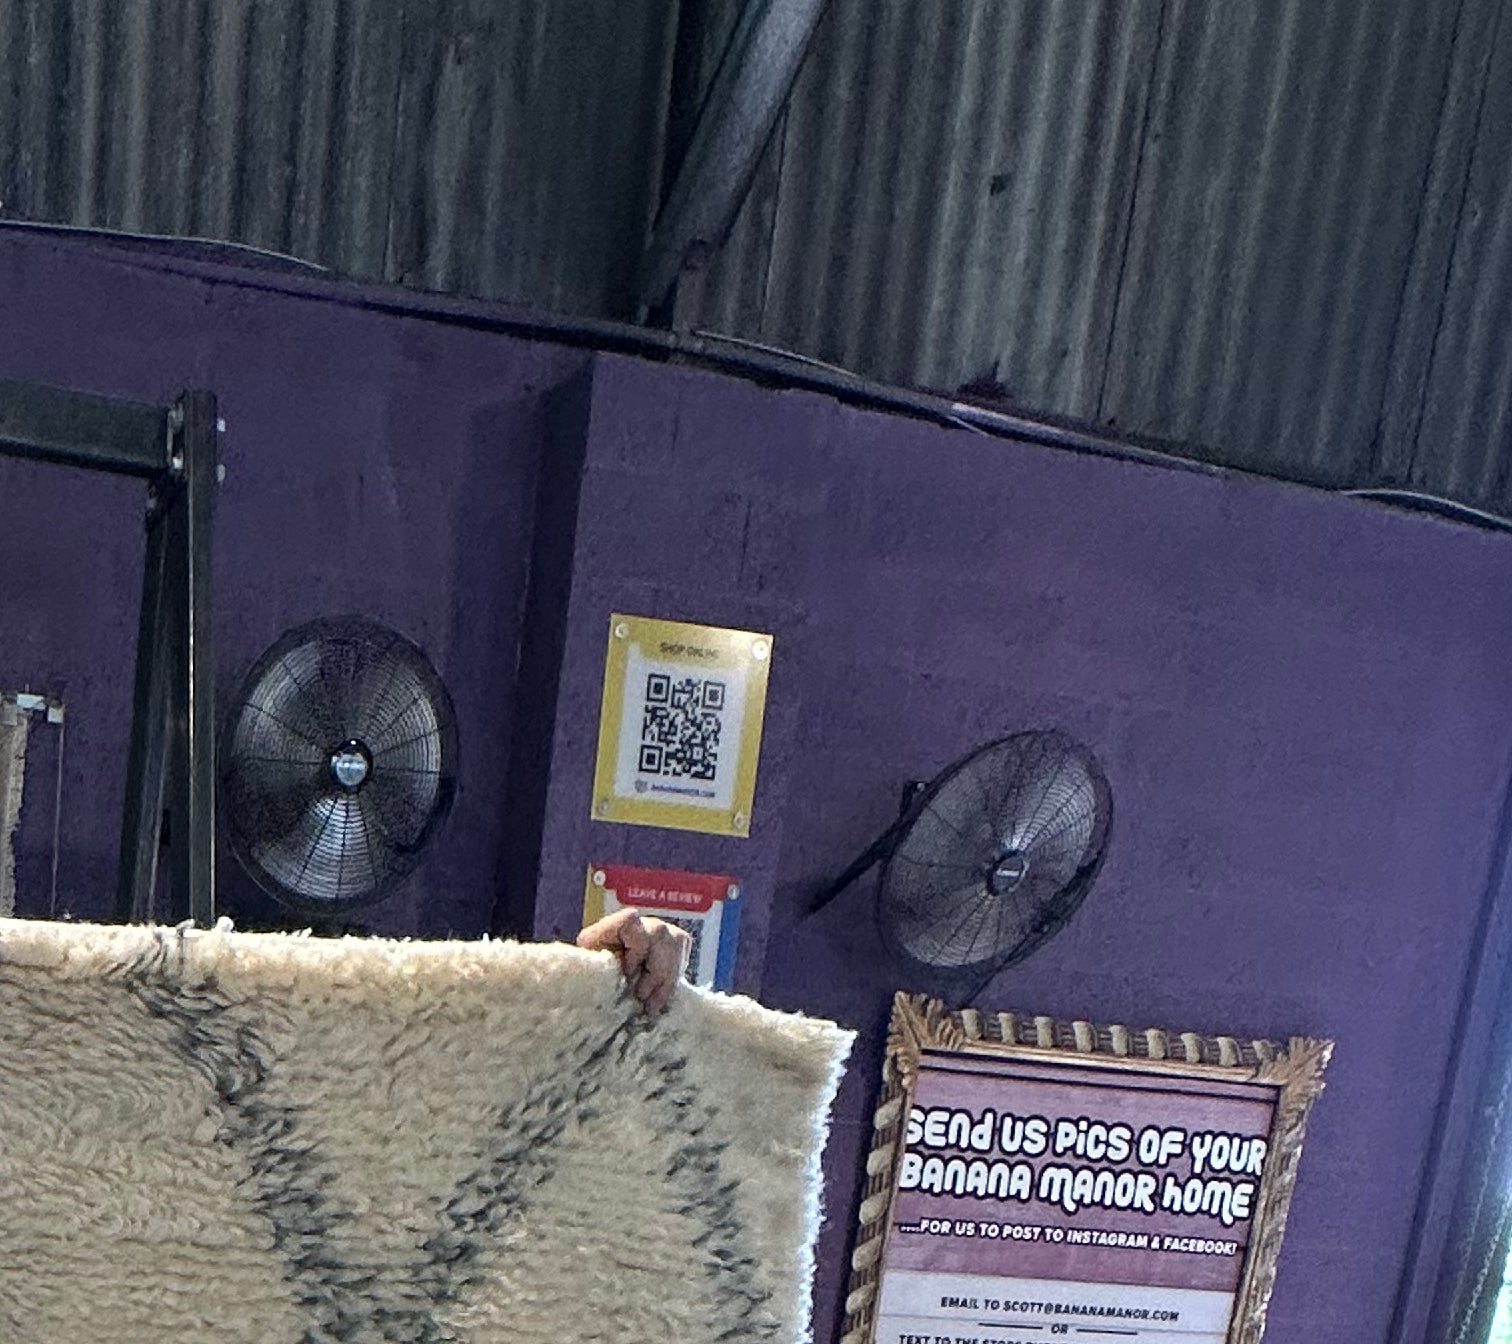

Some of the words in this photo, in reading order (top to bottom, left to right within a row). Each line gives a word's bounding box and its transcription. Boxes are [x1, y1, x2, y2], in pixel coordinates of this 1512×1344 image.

[1001, 1115, 1049, 1155] US
[1138, 1128, 1186, 1166] OF
[1191, 1134, 1268, 1176] YOUR
[954, 1221, 976, 1236] US
[978, 1223, 1000, 1238] TO
[1001, 1224, 1042, 1241] POST
[1044, 1227, 1064, 1243] TO
[1066, 1229, 1149, 1249] INSTAGRAM
[1162, 1236, 1238, 1255] FACEBOOK!
[940, 1296, 980, 1309] EMAIL
[983, 1298, 1000, 1311] TO
[1050, 1323, 1069, 1335] OR
